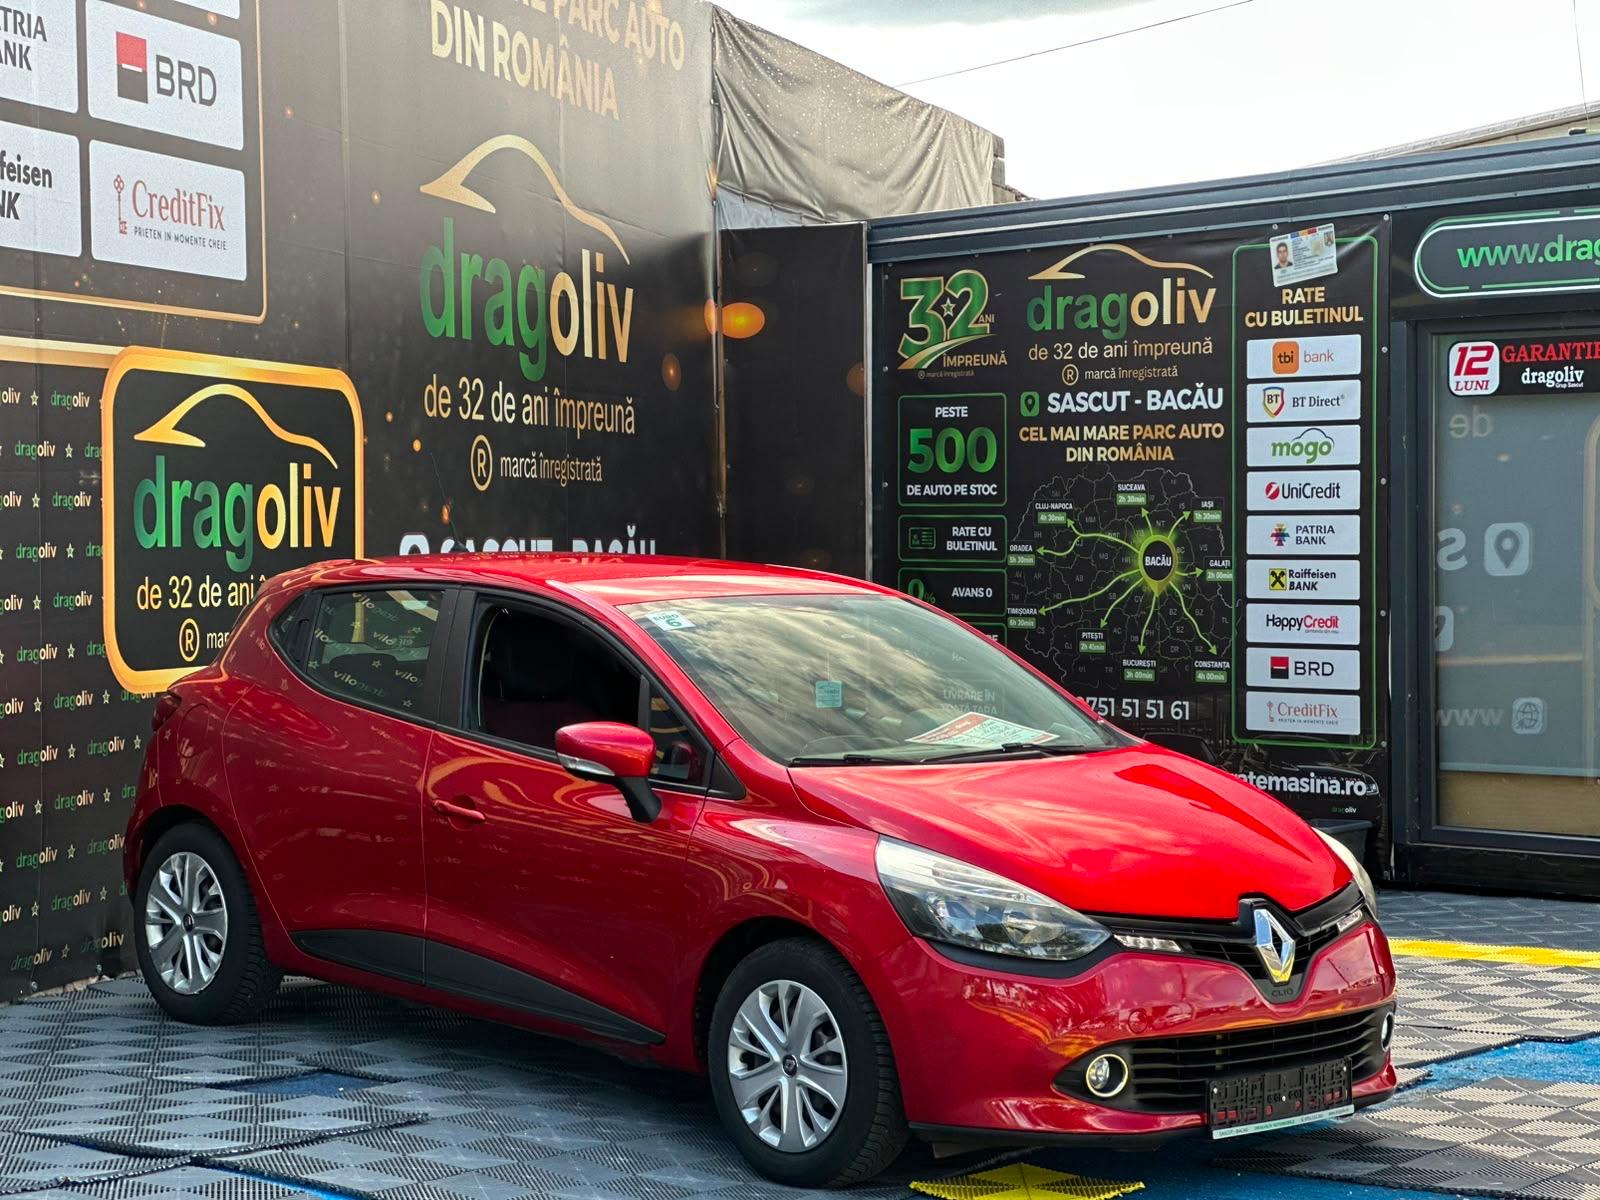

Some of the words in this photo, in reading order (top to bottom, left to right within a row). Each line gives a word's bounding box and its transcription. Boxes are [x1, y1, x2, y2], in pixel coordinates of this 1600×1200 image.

[0, 5, 48, 42] TRIA
[624, 2, 685, 71] AUTO
[431, 0, 486, 72] DIN
[492, 21, 620, 121] ROMÂNIA
[156, 54, 217, 107] BRD
[132, 180, 226, 231] CreditFix
[134, 226, 162, 240] PRIETEN
[164, 231, 172, 241] IN
[174, 233, 206, 247] MOMENTE
[208, 239, 227, 250] CHEIE
[420, 217, 634, 382] dragoliv
[1281, 287, 1325, 304] RATE
[978, 313, 995, 323] ANI
[1026, 276, 1217, 341] dragoliv
[1244, 312, 1267, 328] CU
[1271, 306, 1363, 327] BULETINUL
[943, 350, 1008, 367] ÎMPREUNĂ
[1028, 344, 1048, 361] de
[1053, 343, 1073, 360] 32
[1078, 341, 1099, 359] de
[1103, 340, 1128, 358] ani
[1132, 337, 1213, 361] împreună
[1277, 350, 1294, 364] tbi
[1304, 349, 1334, 364] bank
[1454, 345, 1495, 376] 12
[1084, 366, 1116, 381] marcă
[1117, 364, 1178, 382] înregistrată
[1521, 366, 1584, 387] dragoliv
[1454, 380, 1490, 391] LUNI
[51, 390, 90, 410] dragoliv
[424, 374, 451, 418] de
[458, 376, 485, 421] 32
[491, 381, 516, 424] de
[522, 386, 549, 427] ani
[553, 387, 635, 439] împreună
[1047, 390, 1131, 413] SASCUT
[1146, 382, 1225, 411] BACĂU
[1267, 394, 1280, 404] BT
[1292, 396, 1307, 408] BT
[935, 406, 969, 418] PESTE
[1018, 425, 1048, 442] CEL
[1050, 426, 1080, 441] MAI
[1084, 425, 1129, 441] MARE
[1133, 424, 1176, 440] PARC
[1179, 422, 1225, 440] AUTO
[15, 440, 55, 460] dragoliv
[907, 426, 998, 474] 500
[1065, 446, 1094, 463] DIN
[1096, 442, 1174, 462] ROMÂNIA
[1272, 440, 1333, 464] mogo
[500, 452, 537, 479] marcă
[539, 453, 603, 488] înregistrată
[906, 484, 922, 496] DE
[923, 484, 952, 496] AUTO
[953, 484, 968, 496] PE
[969, 483, 998, 496] STOC
[1117, 483, 1146, 491] SUCEAVA
[1282, 481, 1341, 500] UniCredit
[52, 491, 92, 511] dragoliv
[1035, 502, 1073, 510] CLUJ-NAPOCA
[133, 455, 342, 573] dragoliv
[952, 526, 976, 537] RATE
[977, 526, 992, 537] CU
[1295, 525, 1335, 535] PATRIA
[1295, 535, 1327, 545] BANK
[15, 542, 57, 562] dragoliv
[946, 540, 998, 552] BULETINUL
[1009, 544, 1033, 552] ORADEA
[1144, 554, 1172, 566] BACĂU
[1288, 569, 1336, 579] Raiffeisen
[136, 576, 162, 610] de
[168, 575, 193, 609] 32
[199, 575, 222, 608] de
[227, 574, 255, 607] ani
[951, 587, 984, 598] AVANS
[985, 587, 993, 598] 0
[1288, 580, 1318, 591] BANK
[53, 591, 93, 611] dragoliv
[665, 617, 683, 628] 6
[1266, 614, 1339, 631] HappyCredit
[206, 631, 229, 649] mar
[16, 643, 58, 664] dragoliv
[1294, 661, 1335, 677] BRD
[53, 690, 94, 711] dragoliv
[1077, 696, 1115, 716] 751
[1121, 698, 1139, 718] 51
[1146, 699, 1164, 719] 51
[1170, 700, 1190, 720] 61
[1277, 701, 1338, 719] CreditFix
[17, 745, 58, 767] dragoliv
[87, 736, 125, 757] dragoliv
[55, 790, 94, 810] dragoliv
[16, 847, 58, 868] dragoliv
[87, 834, 125, 855] dragoliv
[51, 889, 91, 911] dragoliv
[11, 948, 52, 970] dragoliv
[1271, 987, 1293, 998] CLIO
